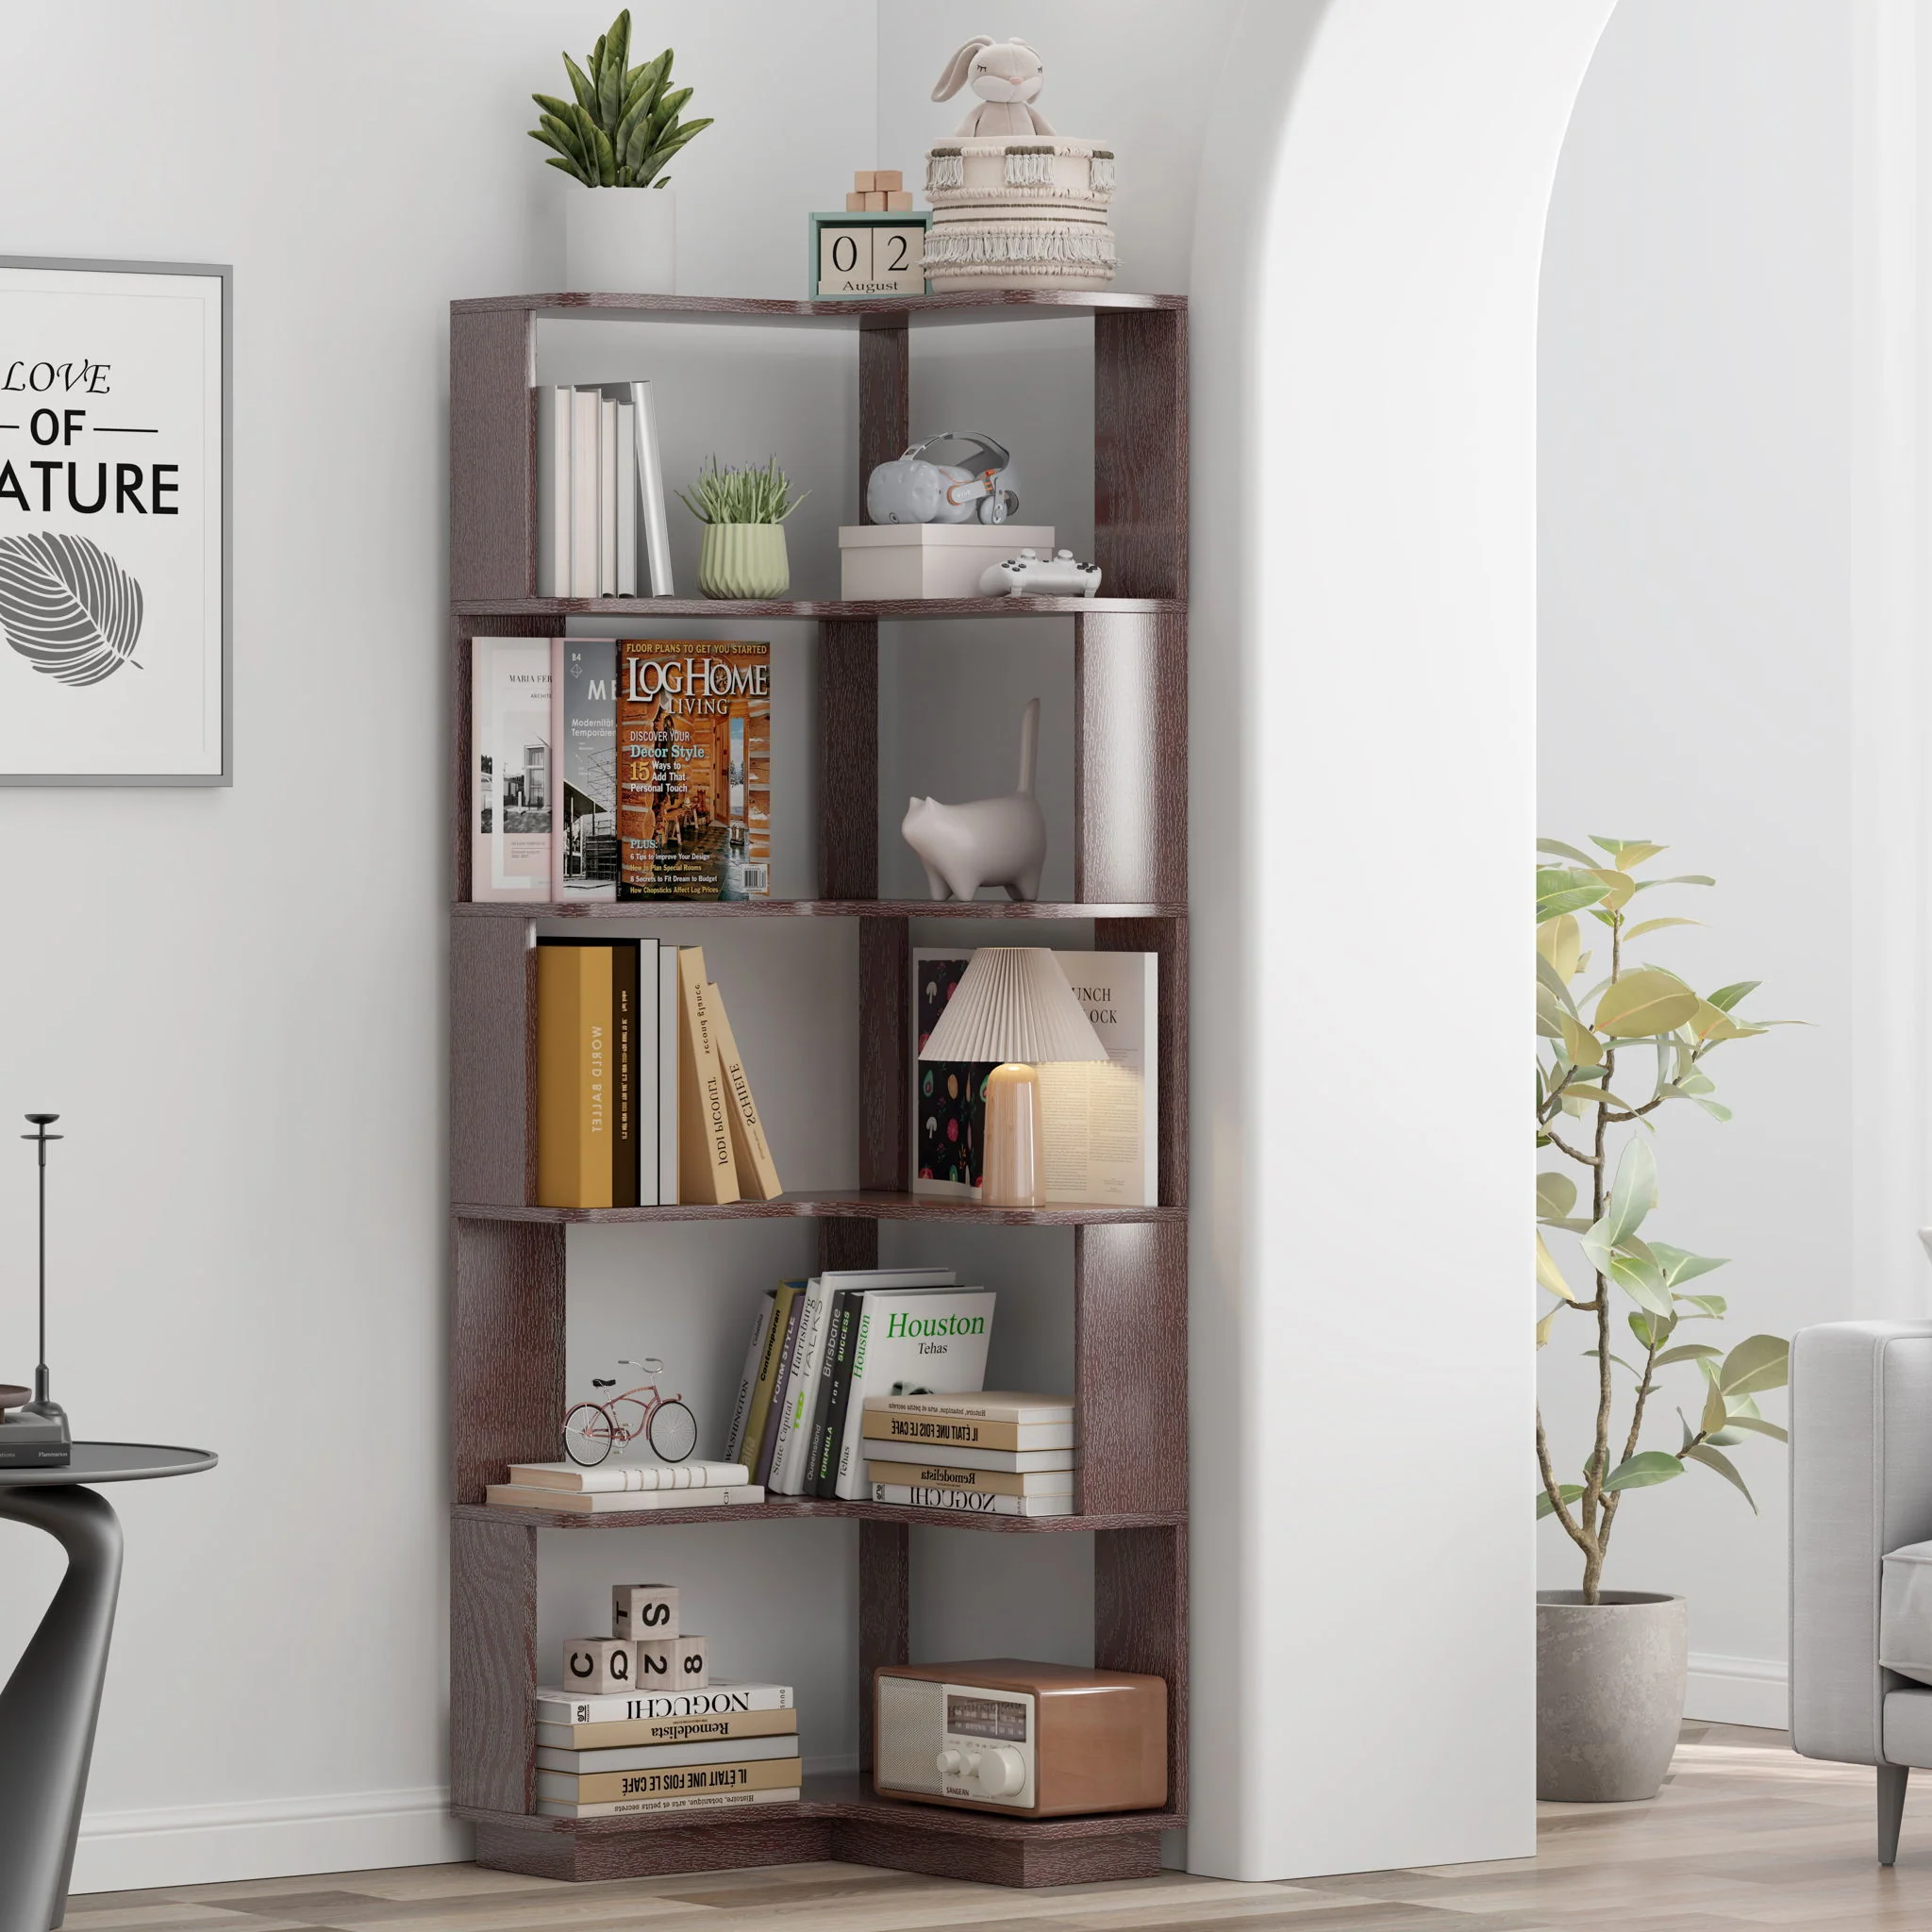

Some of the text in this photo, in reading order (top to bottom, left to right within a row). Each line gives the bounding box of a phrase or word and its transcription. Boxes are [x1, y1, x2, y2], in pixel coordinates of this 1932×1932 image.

[842, 280, 899, 292] August
[1, 358, 111, 394] LOVE
[30, 408, 86, 446] OF
[0, 459, 179, 515] ATURE
[626, 643, 652, 653] FLOOR
[655, 643, 681, 653] PLANS
[683, 644, 693, 653] TO
[695, 644, 710, 654] GET
[714, 644, 730, 654] YOU
[733, 645, 767, 654] STARTED
[509, 675, 535, 683] MARIA
[669, 698, 728, 714] LIVING
[630, 731, 690, 741] DISCOVER YOUR
[630, 745, 705, 761] Decor Style
[630, 761, 650, 781] 15
[652, 761, 671, 771] Ways
[652, 773, 686, 781] Add That
[631, 783, 687, 792] Personal Touch
[630, 840, 658, 849] PLUS:
[1090, 1009, 1117, 1024] OCK
[886, 1312, 985, 1339] Houston
[760, 1309, 780, 1381] Contemporan
[918, 1342, 948, 1355] Tehas
[773, 1316, 795, 1403] FORM STYLE
[793, 1300, 823, 1429] TED TALKS
[773, 1297, 815, 1475] State Capital Harrisburg
[807, 1308, 841, 1481] Queensland Brisbane
[820, 1311, 850, 1479] FORMULA FOR SUCCESS
[839, 1315, 870, 1477] Tehas Houston
[725, 1380, 749, 1460] WASHINGTON
[616, 1601, 628, 1624] T
[642, 1603, 670, 1627] S
[570, 1652, 594, 1678] C
[610, 1649, 628, 1681] Q
[644, 1654, 667, 1674] 2
[684, 1655, 702, 1674] 8
[626, 1692, 749, 1719] NOGUCHI
[651, 1722, 729, 1739] Remodelista
[622, 1769, 747, 1796] IL ÉTAIT UNE FOIS LE CAFÉ
[614, 1804, 640, 1812] secrets
[641, 1800, 661, 1810] petits
[688, 1796, 723, 1807] botanique,
[725, 1794, 754, 1804] Histoire,
